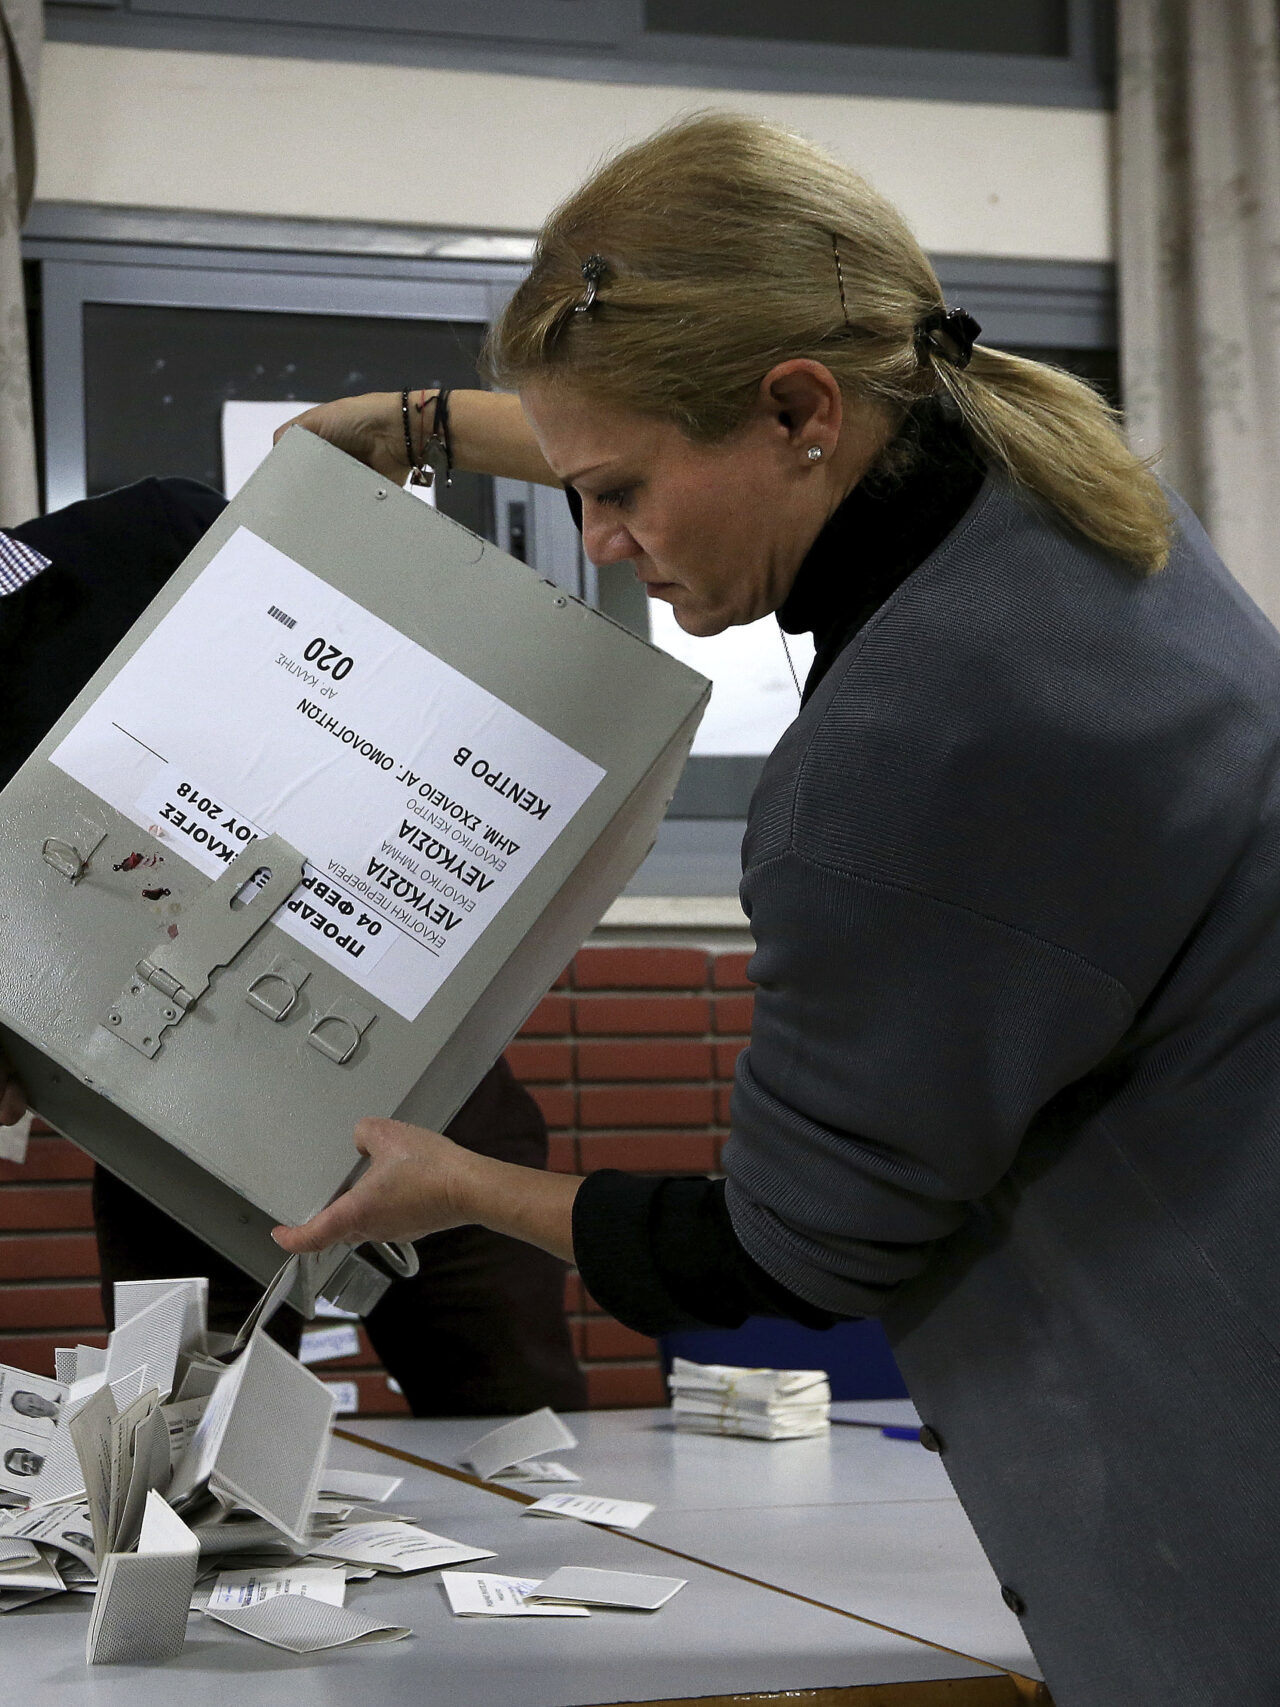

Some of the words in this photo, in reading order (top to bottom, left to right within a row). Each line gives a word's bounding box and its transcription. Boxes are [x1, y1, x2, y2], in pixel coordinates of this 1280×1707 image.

[275, 653, 319, 687] ΚΑΛΠΗΣ
[304, 638, 354, 680] 020
[297, 698, 395, 771] ΟΜΟΛΟΓΗΤΩΝ
[176, 782, 224, 820] 2018
[419, 783, 482, 832] ΣΧΟΛΕΙΟ
[471, 760, 552, 820] ΚΕΝΤΡΟ
[158, 802, 239, 866] ΚΛΟΓΕΣ
[406, 798, 453, 835] ΚΕΝΤΡΟ
[381, 840, 420, 874] ΤΜΗΜΑ
[398, 818, 495, 893] ΛΕΥΚΩΣΙΑ
[451, 829, 507, 872] ΕΚΛΟΓΙΚΟ
[482, 824, 520, 856] ΔΗΜ.
[327, 859, 391, 910] ΠΕΡΙΦΕΡΕΙΑ
[366, 857, 463, 931] ΛΕΥΚΩΣΙΑ
[420, 870, 477, 913] ΕΚΛΟΓΙΚΟ
[356, 912, 382, 936] 04
[390, 906, 447, 949] ΕΚΛΟΓΙΚΗ
